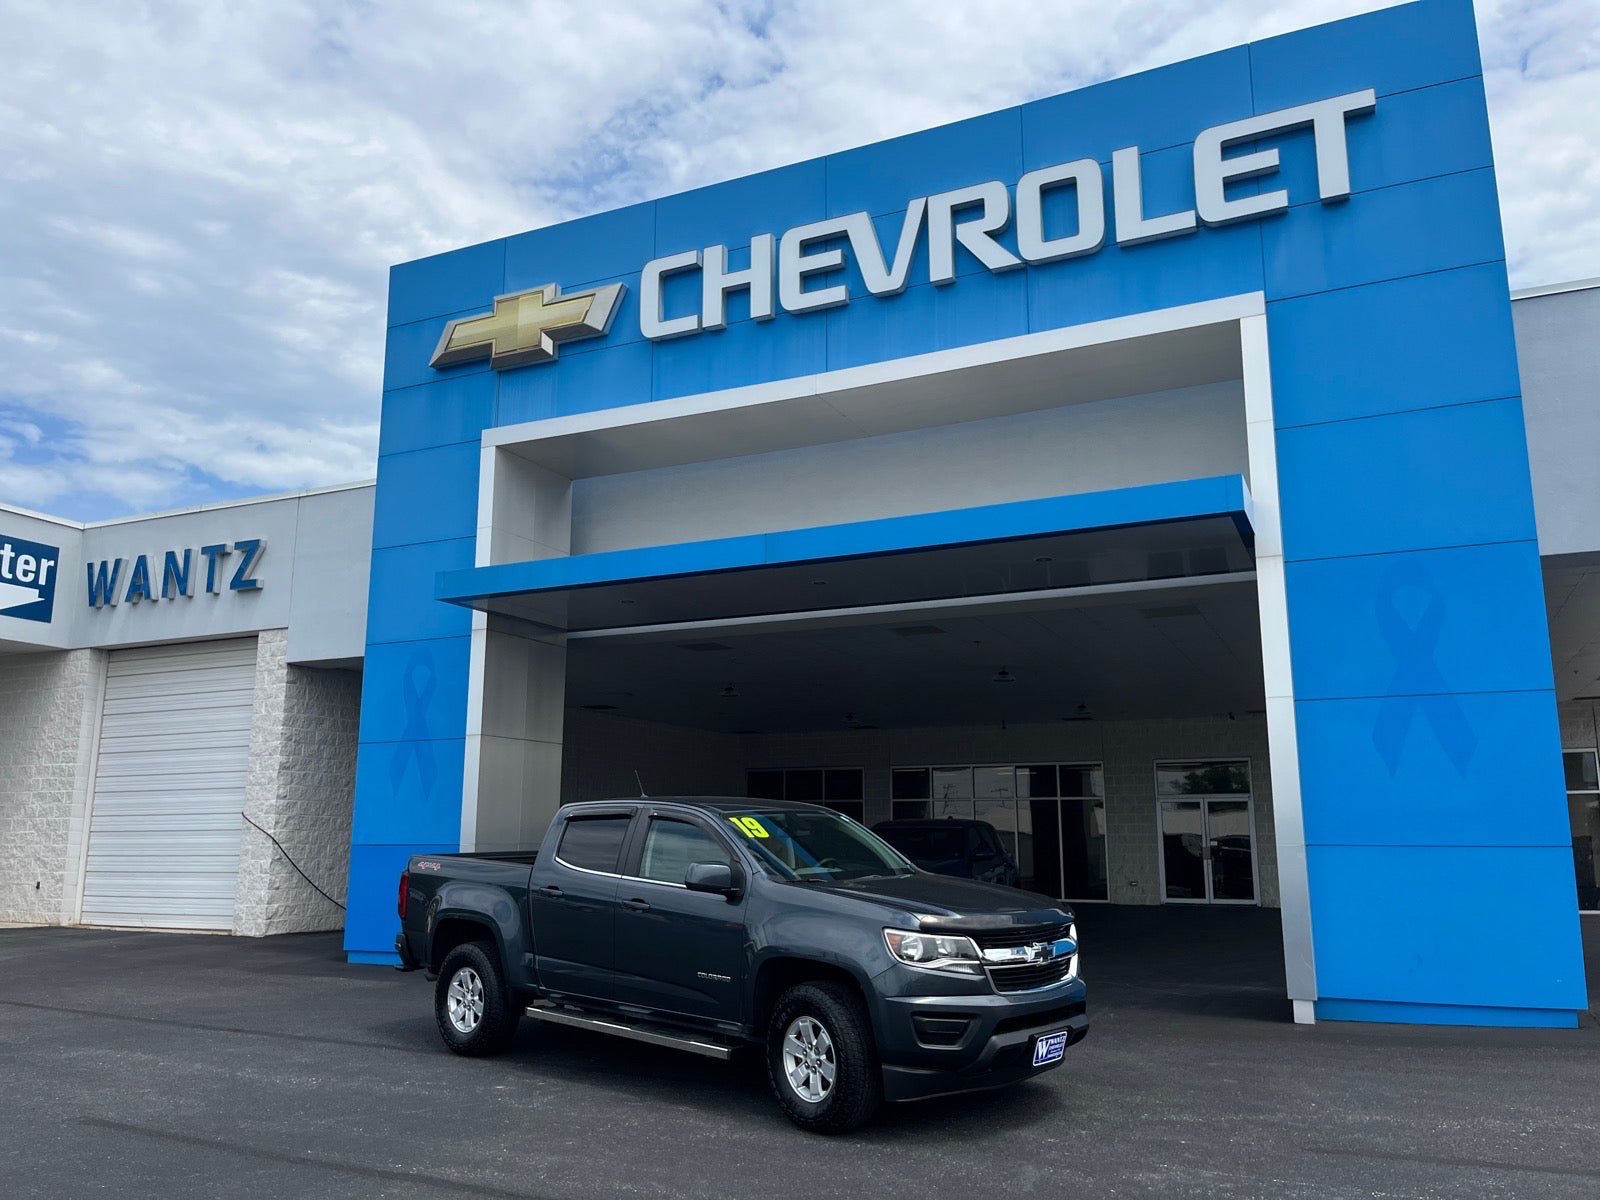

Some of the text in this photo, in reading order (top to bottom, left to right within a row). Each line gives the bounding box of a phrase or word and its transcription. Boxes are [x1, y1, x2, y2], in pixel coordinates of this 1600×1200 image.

[640, 89, 1376, 342] CHEVROLET
[87, 539, 266, 608] WANTZ
[728, 817, 769, 839] 19
